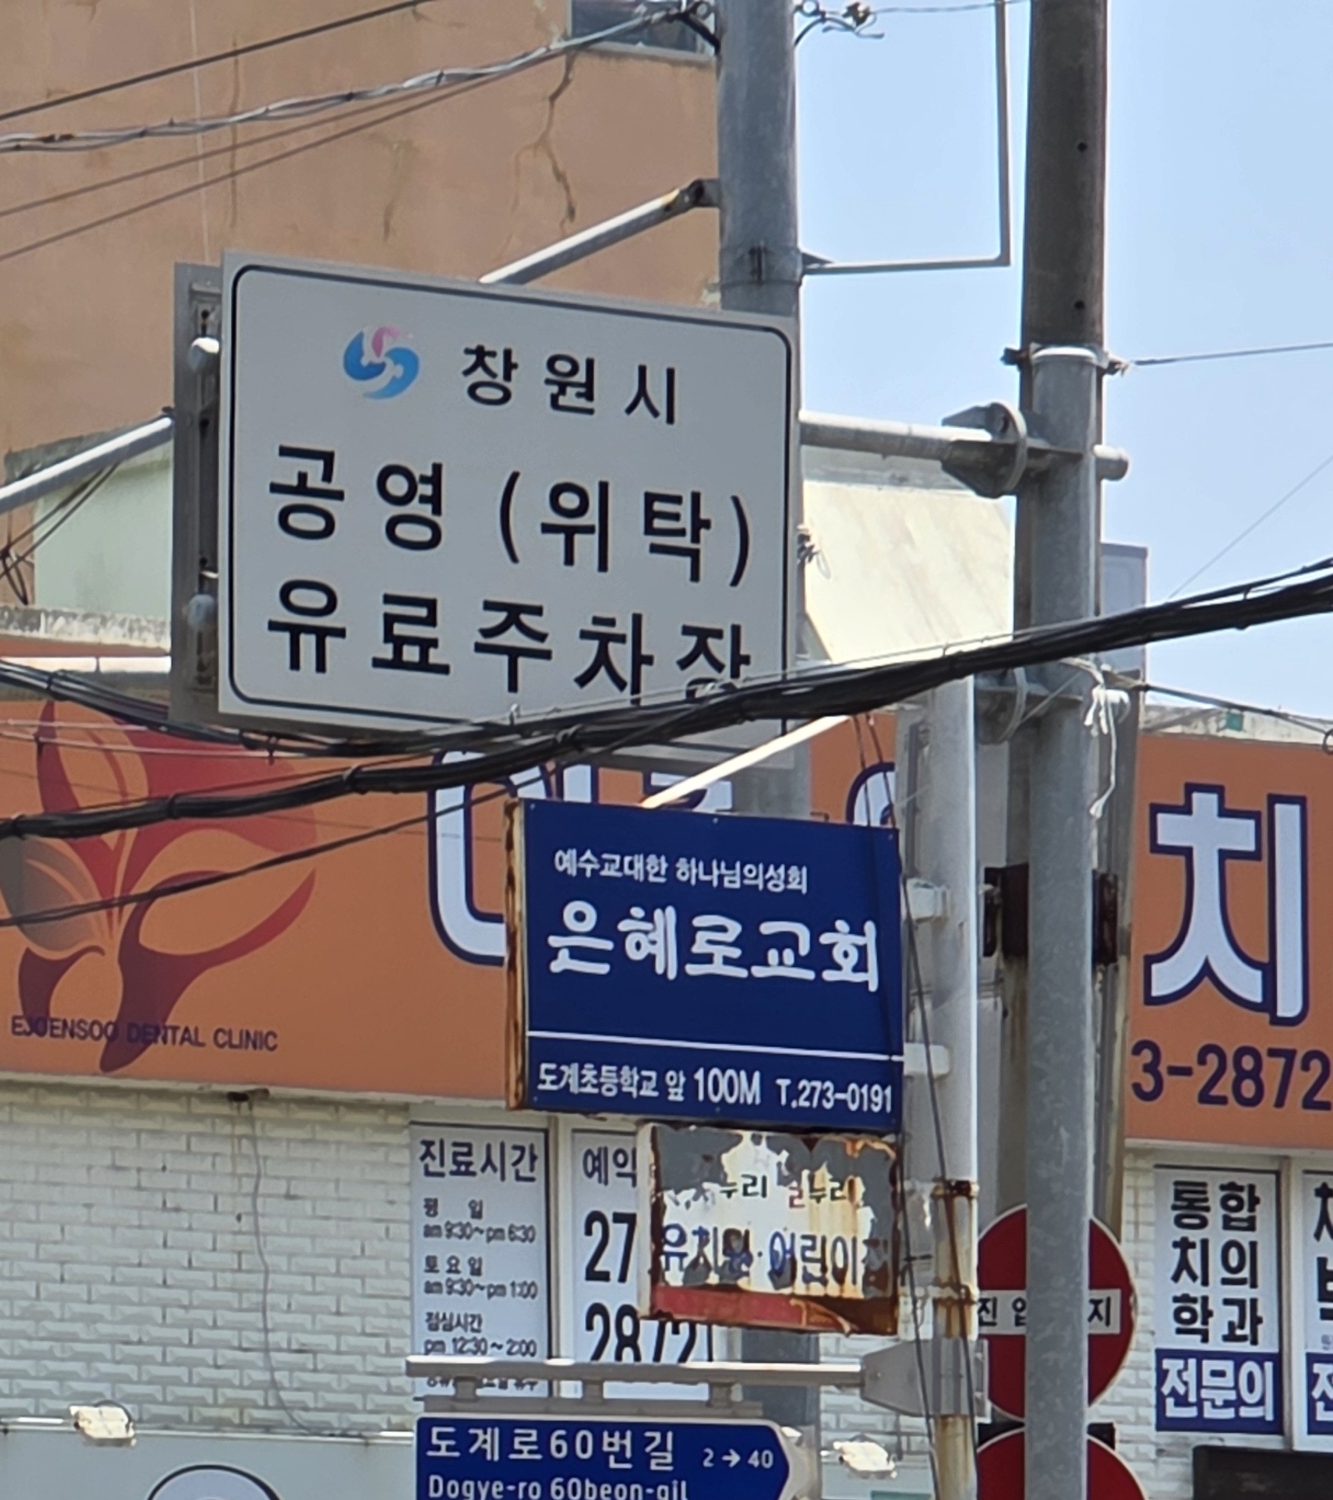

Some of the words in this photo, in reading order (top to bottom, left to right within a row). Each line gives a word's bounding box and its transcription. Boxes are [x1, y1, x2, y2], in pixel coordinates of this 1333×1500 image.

[462, 345, 676, 425] 창원시
[269, 445, 444, 552] 공영
[499, 471, 750, 587] (위탁)
[267, 579, 751, 707] 유료주차장
[554, 849, 668, 883] 예수교대한
[675, 861, 808, 894] 하나님의성회
[1143, 782, 1310, 1026] 치
[548, 900, 879, 992] 은혜로교회
[126, 1021, 207, 1049] DENTAL
[213, 1027, 279, 1053] CLINIC
[537, 1062, 659, 1099] 도계초등학교
[666, 1074, 685, 1102] 앞
[694, 1068, 761, 1105] 100M
[776, 1078, 893, 1114] T.273-0191
[1131, 1039, 1332, 1111] 3-2872
[419, 1138, 539, 1183] 진료시간
[1171, 1180, 1261, 1232] 통합
[1170, 1236, 1258, 1290] 치의
[1171, 1293, 1264, 1347] 학과
[1160, 1357, 1275, 1421] 전문의
[426, 1427, 675, 1472] 도계로60번길
